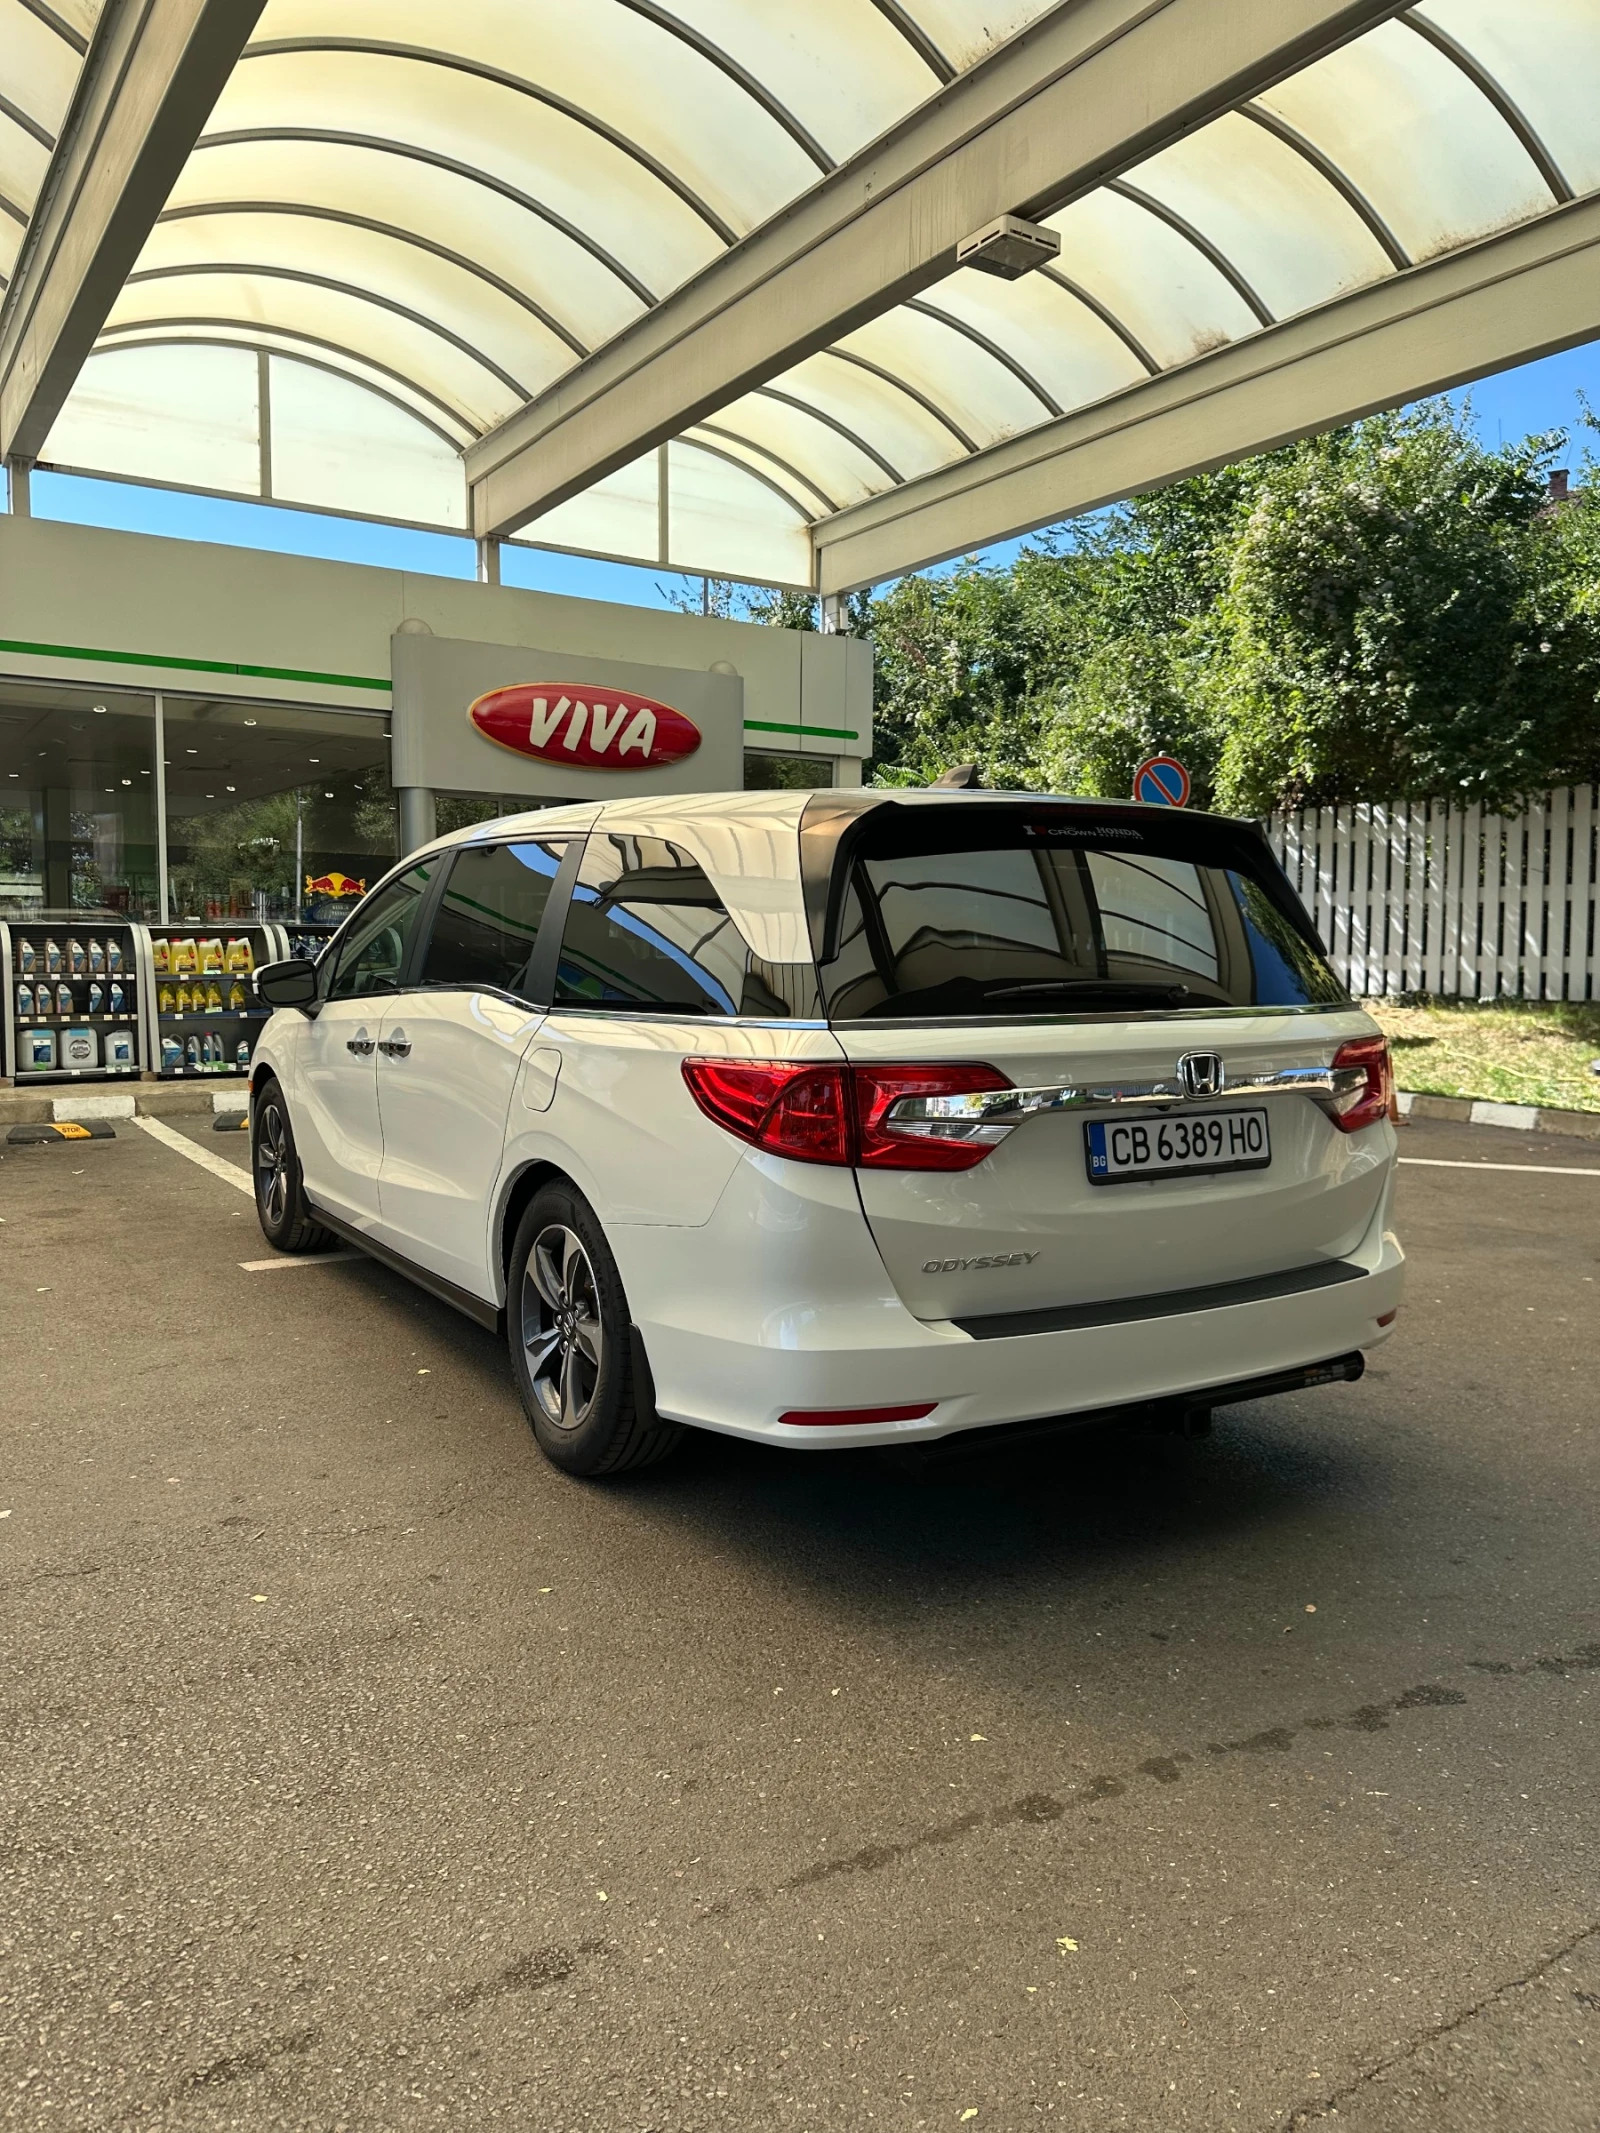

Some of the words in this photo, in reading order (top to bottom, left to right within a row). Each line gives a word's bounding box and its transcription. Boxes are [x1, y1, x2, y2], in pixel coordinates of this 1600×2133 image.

[529, 696, 657, 758] VIVA
[1095, 827, 1141, 837] HONDA
[1111, 1126, 1151, 1165] CB
[1157, 1120, 1223, 1161] 6389
[1228, 1116, 1262, 1155] HO
[1092, 1155, 1106, 1167] BG
[921, 1250, 1041, 1274] ODYSSEY
